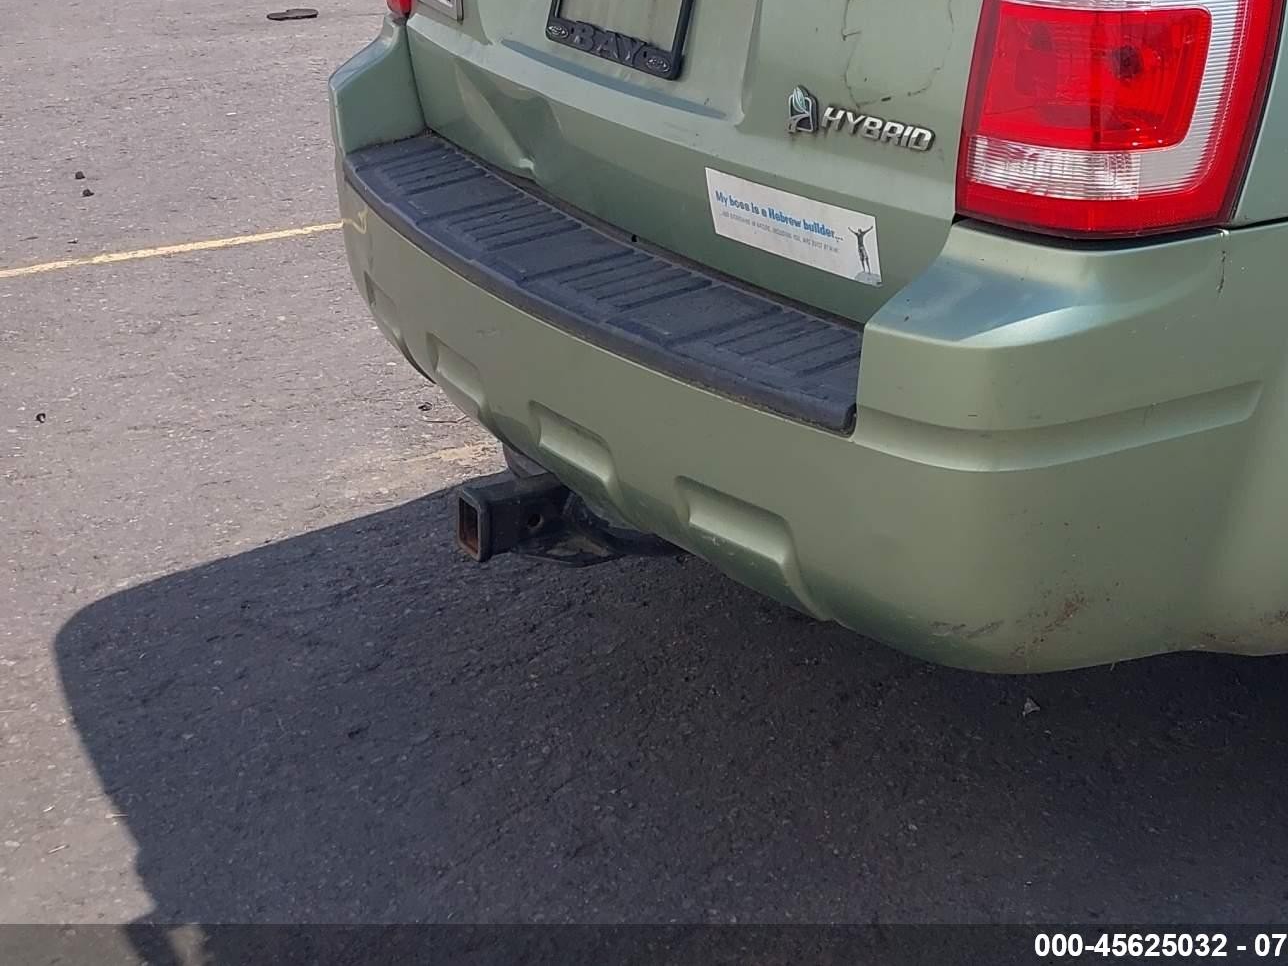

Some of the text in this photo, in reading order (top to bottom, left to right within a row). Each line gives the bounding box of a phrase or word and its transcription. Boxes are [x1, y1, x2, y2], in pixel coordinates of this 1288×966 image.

[821, 107, 933, 151] HYBRID
[715, 190, 728, 207] My
[729, 194, 750, 212] boss
[768, 207, 801, 228] Hebrew
